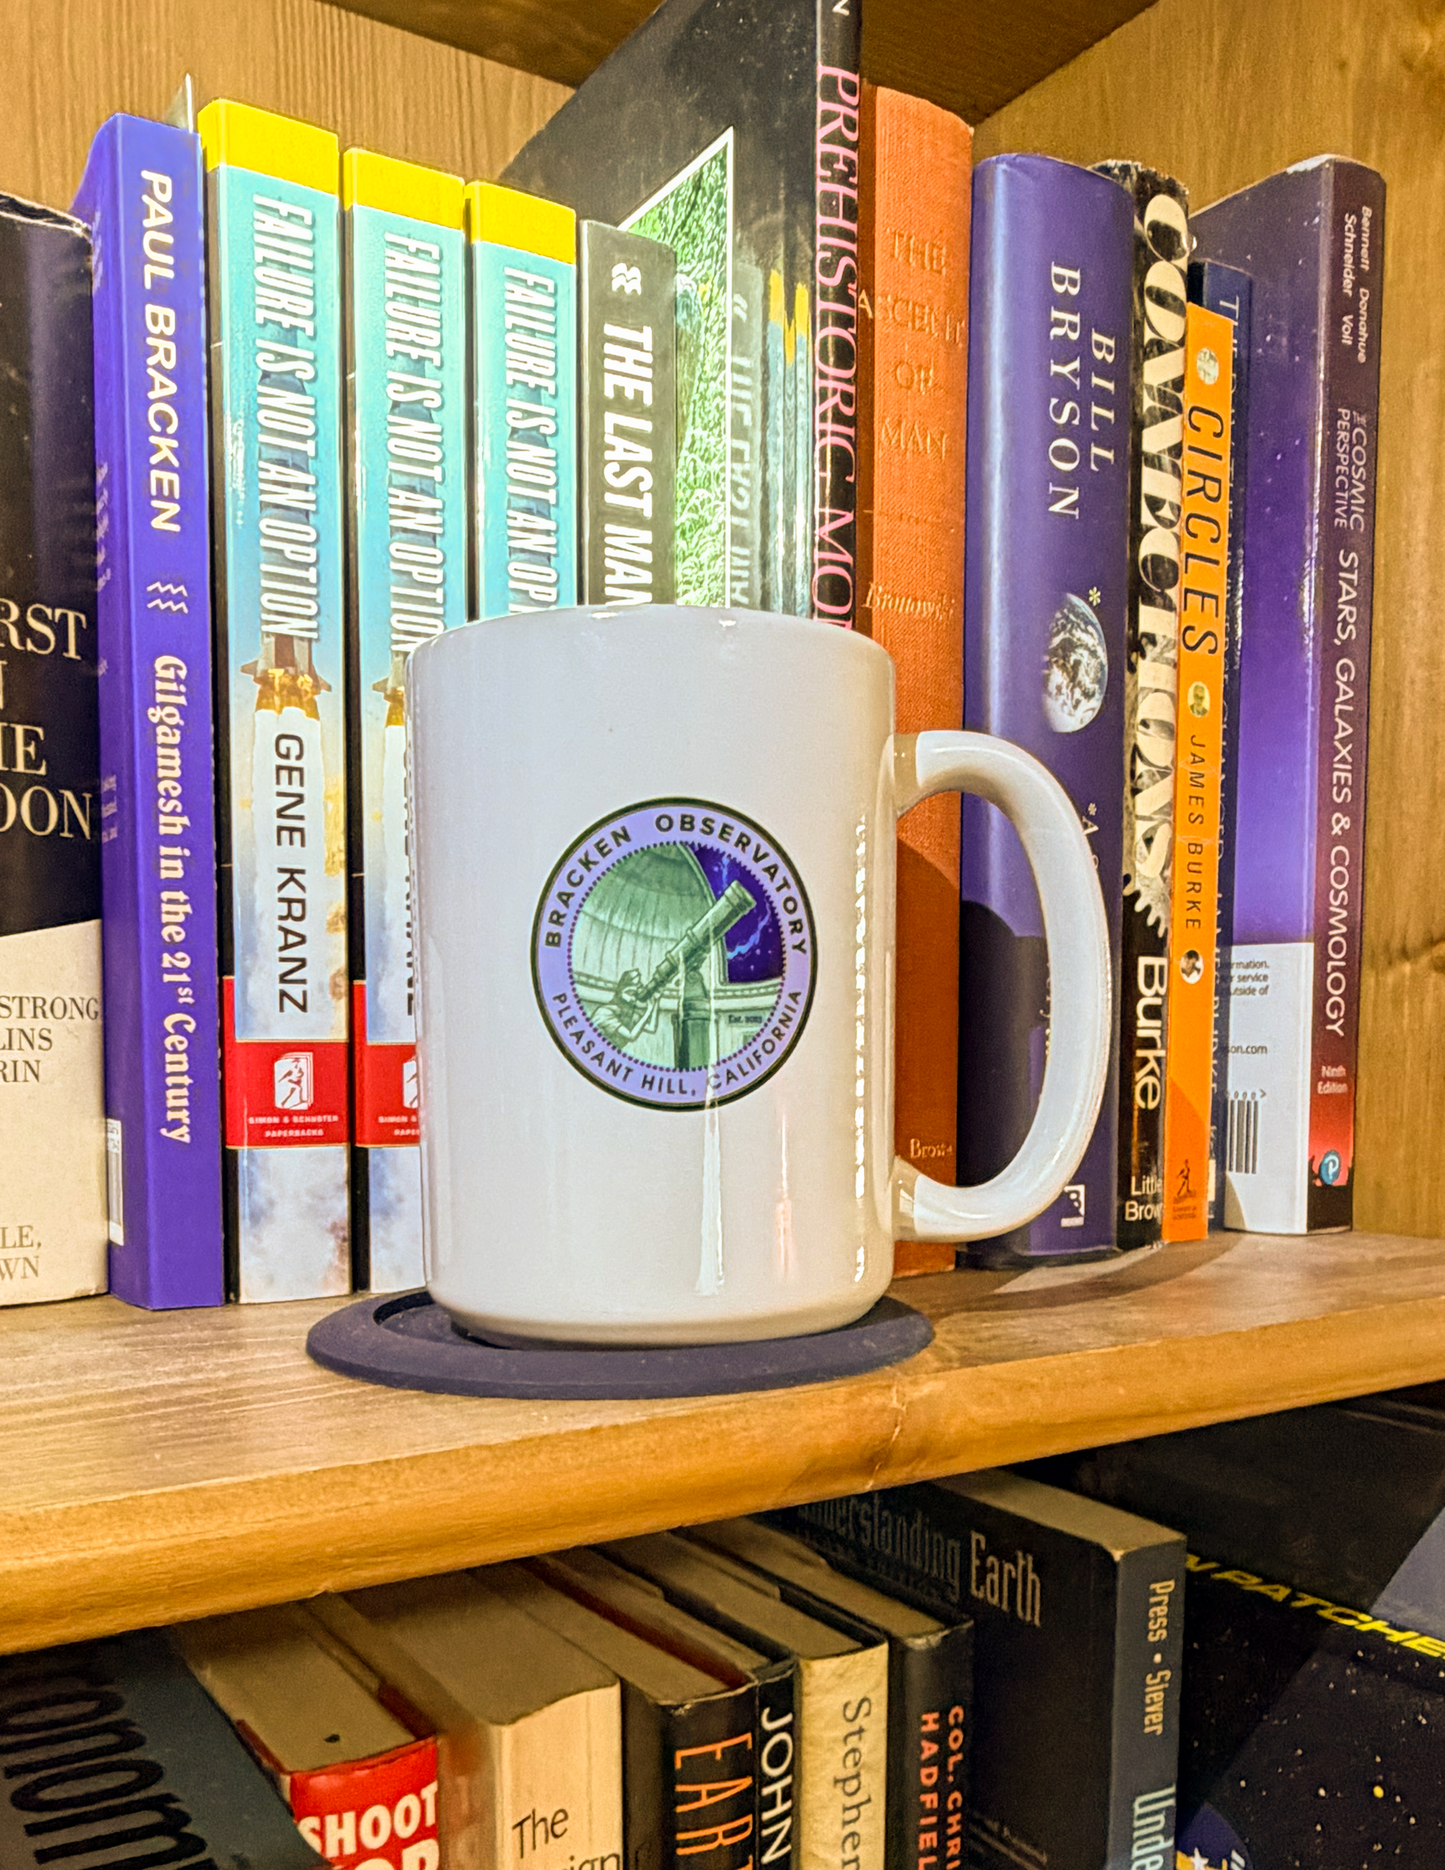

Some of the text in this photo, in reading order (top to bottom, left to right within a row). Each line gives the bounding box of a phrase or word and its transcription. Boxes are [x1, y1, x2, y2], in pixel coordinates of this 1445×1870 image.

[815, 61, 860, 484] PREHISTORIC
[885, 228, 947, 275] THE
[1341, 213, 1357, 345] Schneider Voit
[1357, 205, 1372, 364] Bennett Donahue
[141, 169, 181, 533] PAUL BRACKEN
[504, 266, 556, 396] FAILURE
[603, 323, 653, 407] THE
[1048, 261, 1081, 520] BRYSON
[253, 194, 319, 640] FAILURE IS NOT AN OPTION
[384, 231, 445, 652] FAILURE IS NOT AN OPTION
[506, 397, 557, 435] IS
[603, 411, 653, 519] LAST
[881, 416, 947, 460] MAN
[1089, 327, 1116, 472] BILL
[506, 437, 558, 504] NOT
[507, 509, 558, 556] AN
[1181, 404, 1224, 656] CIRCLES
[1334, 408, 1350, 529] PERSPECTIVE
[1350, 427, 1367, 533] COSMIC
[1134, 193, 1189, 880] CONNECTIONS
[0, 723, 47, 776] E
[147, 654, 190, 836] Gilgamesh
[1325, 549, 1359, 1037] STARS, GALAXIES & COSMOLOGY
[160, 844, 191, 880] in
[274, 733, 308, 1014] GENE KRANZ
[545, 825, 632, 948] BRACKEN
[654, 813, 807, 955] OBSERVATORY
[1185, 735, 1206, 930] JAMES BURKE
[160, 887, 193, 944] the
[0, 995, 99, 1021] STRONG
[552, 990, 803, 1097] PLEASANT HILL, CALIFORNIA
[1134, 956, 1168, 1111] Burke
[161, 1013, 196, 1145] Century
[969, 1530, 1042, 1628] Earth
[1211, 1570, 1445, 1660] PATCHE
[1143, 1579, 1176, 1736] Press Siever
[674, 1731, 754, 1870] EAR
[760, 1706, 794, 1865] JOHN
[948, 1705, 964, 1783] COL.
[300, 1781, 439, 1858] SHOOT
[511, 1807, 569, 1859] The
